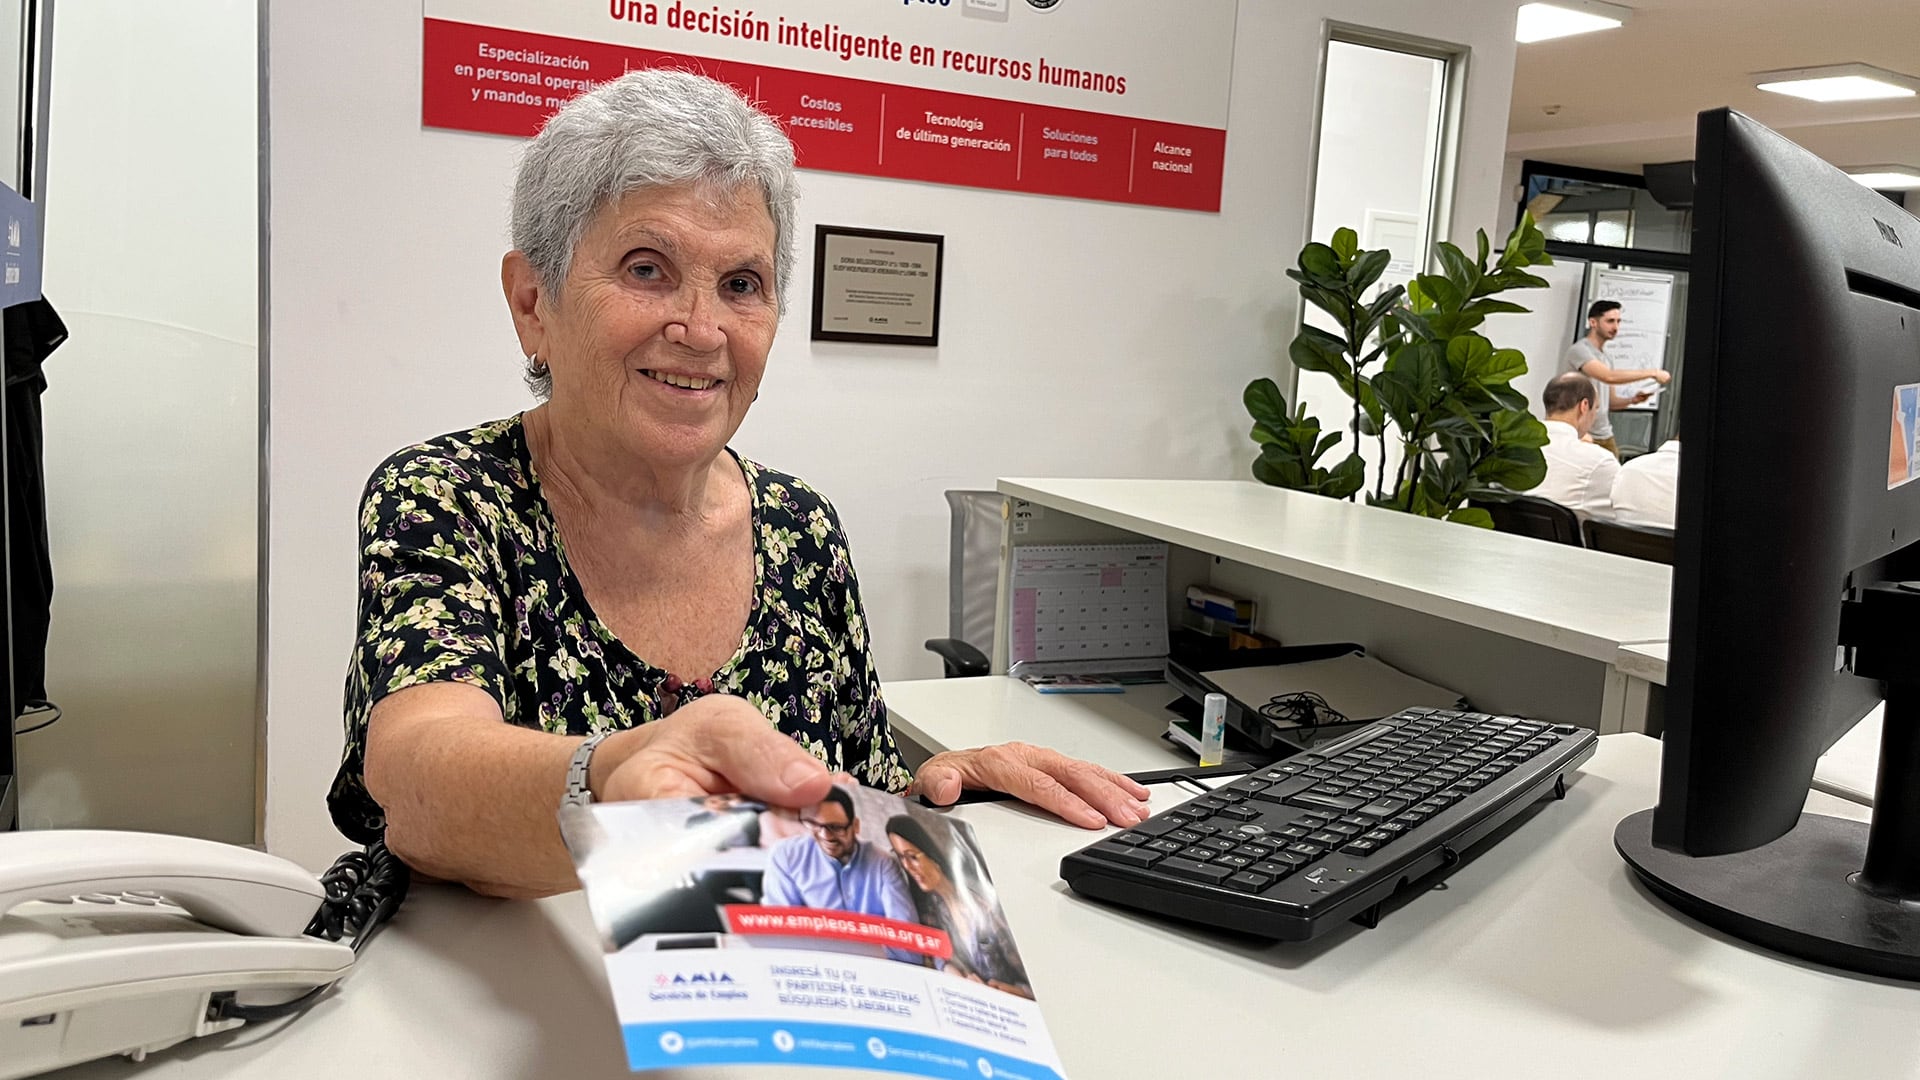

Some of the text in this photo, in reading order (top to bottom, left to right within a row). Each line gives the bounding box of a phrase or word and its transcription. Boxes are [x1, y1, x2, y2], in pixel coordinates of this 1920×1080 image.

[478, 42, 590, 70] Especialización
[610, 0, 1127, 95] Una decisión inteligente en recursos humanos
[454, 64, 473, 76] en
[477, 67, 541, 85] personal
[471, 88, 481, 101] y
[484, 89, 542, 106] mandos
[800, 95, 842, 112] Costos
[790, 115, 854, 133] accesibles
[925, 111, 984, 132] Tecnología
[896, 127, 1011, 152] de última generación
[1042, 127, 1099, 145] Soluciones
[1043, 147, 1099, 163] para todos
[1153, 142, 1192, 157] Alcance
[1152, 160, 1193, 174] nacional
[738, 913, 942, 949] www.empleos.amia.org.ar
